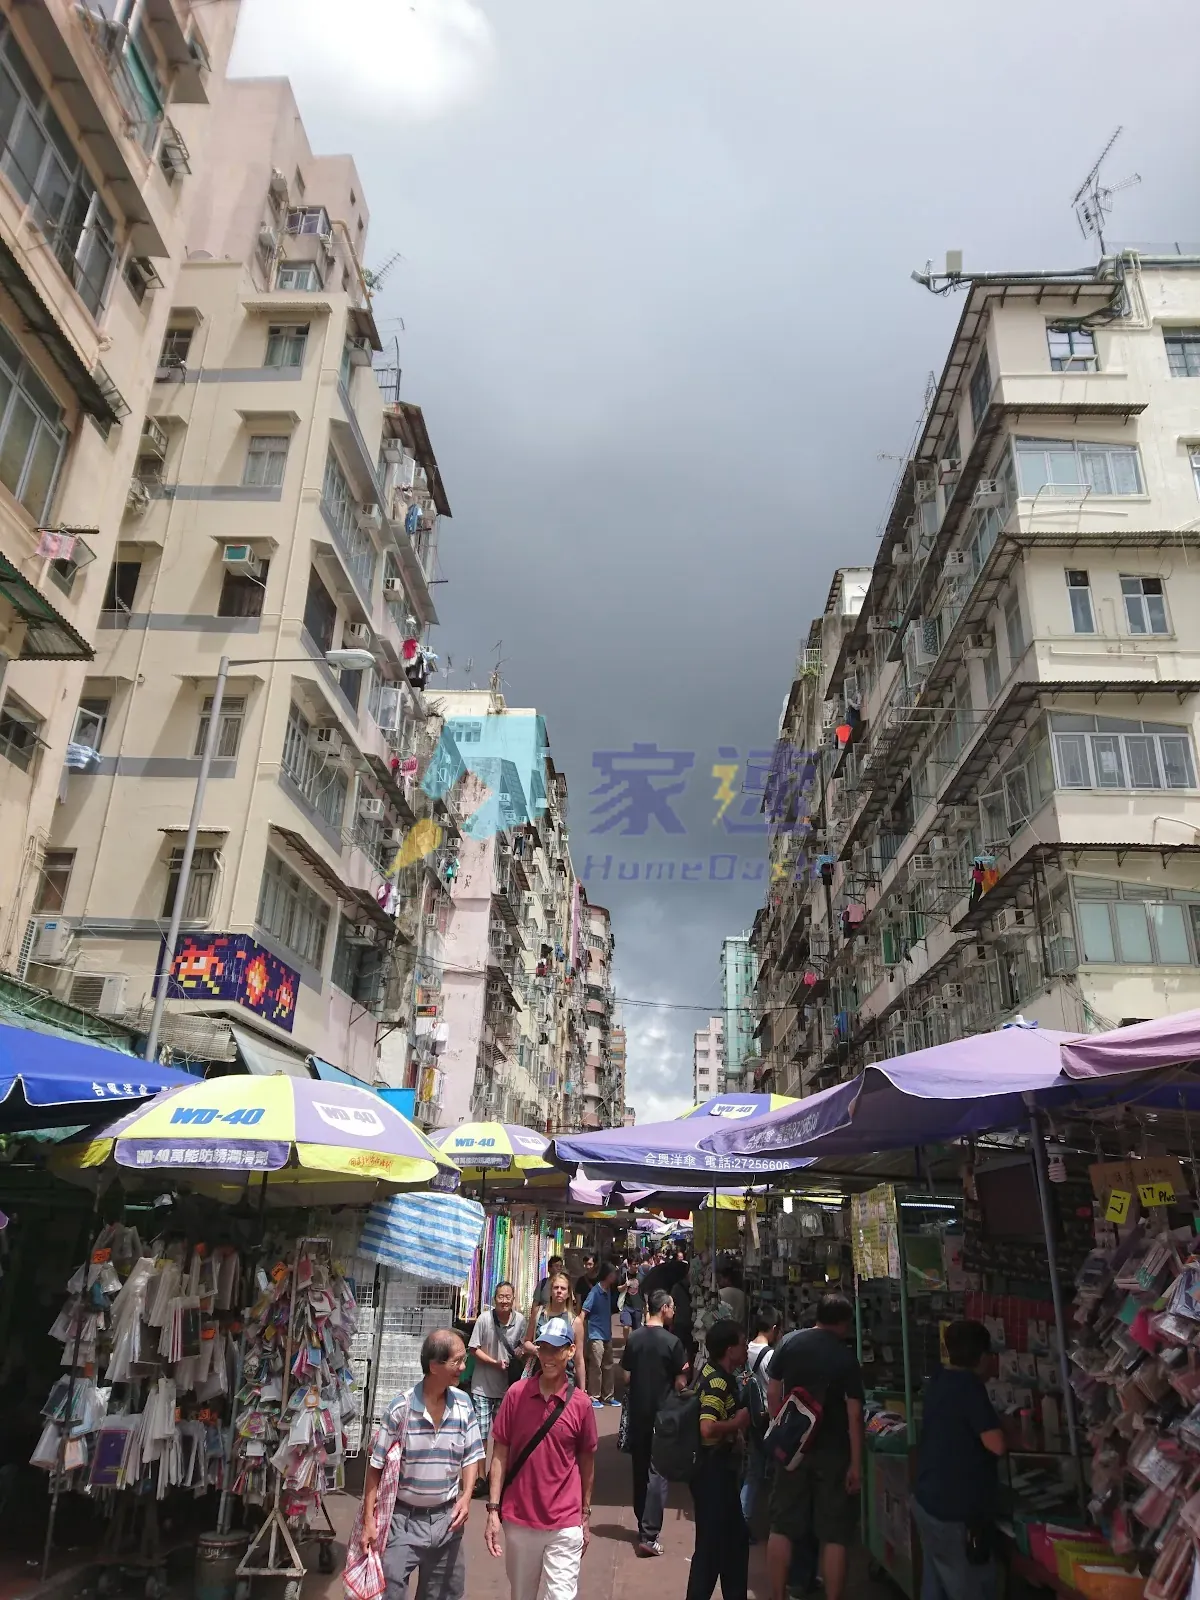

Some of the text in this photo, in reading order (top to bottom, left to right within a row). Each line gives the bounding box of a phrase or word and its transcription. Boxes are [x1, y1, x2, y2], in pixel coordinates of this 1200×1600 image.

[169, 1107, 266, 1126] WD-40
[455, 1137, 495, 1147] WD-40
[644, 1152, 790, 1170] 合興洋傘 電話:27256606
[1141, 1187, 1177, 1203] i7 Plus
[1109, 1194, 1127, 1215] i7
